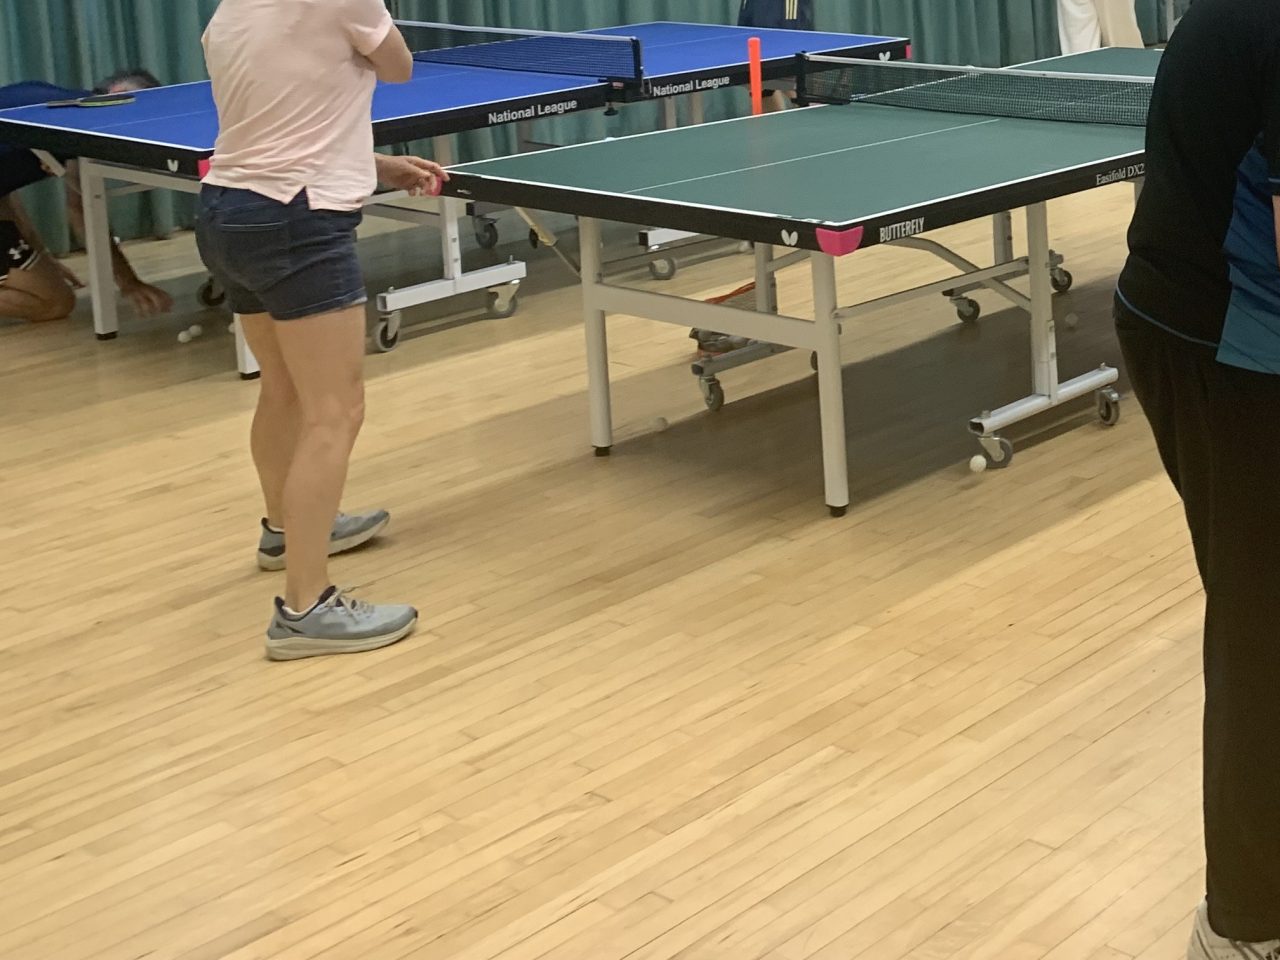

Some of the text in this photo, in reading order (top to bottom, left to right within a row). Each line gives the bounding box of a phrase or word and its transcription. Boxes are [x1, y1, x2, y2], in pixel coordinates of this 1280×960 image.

[652, 76, 730, 97] National League
[488, 100, 578, 124] National League
[879, 216, 925, 243] BUTTERFLY
